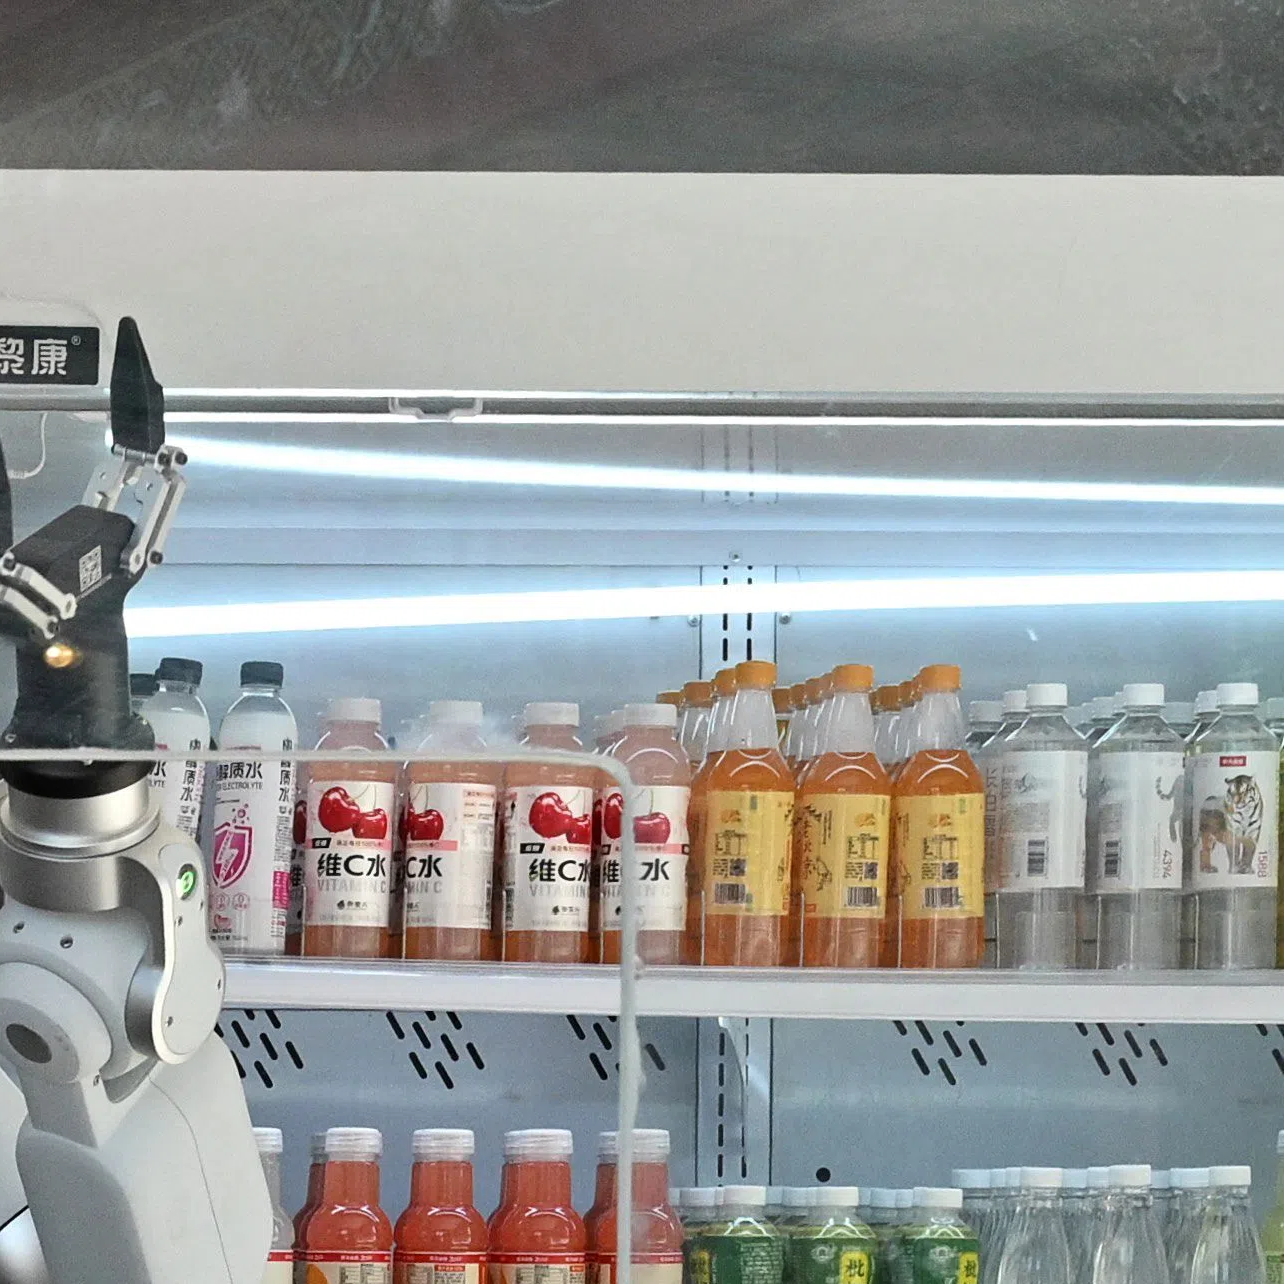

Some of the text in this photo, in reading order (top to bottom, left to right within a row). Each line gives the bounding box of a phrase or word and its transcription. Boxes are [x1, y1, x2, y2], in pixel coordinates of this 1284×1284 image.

[222, 781, 263, 791] ELECTROLYTE
[317, 852, 386, 878] 维C水
[602, 857, 671, 883] 维水
